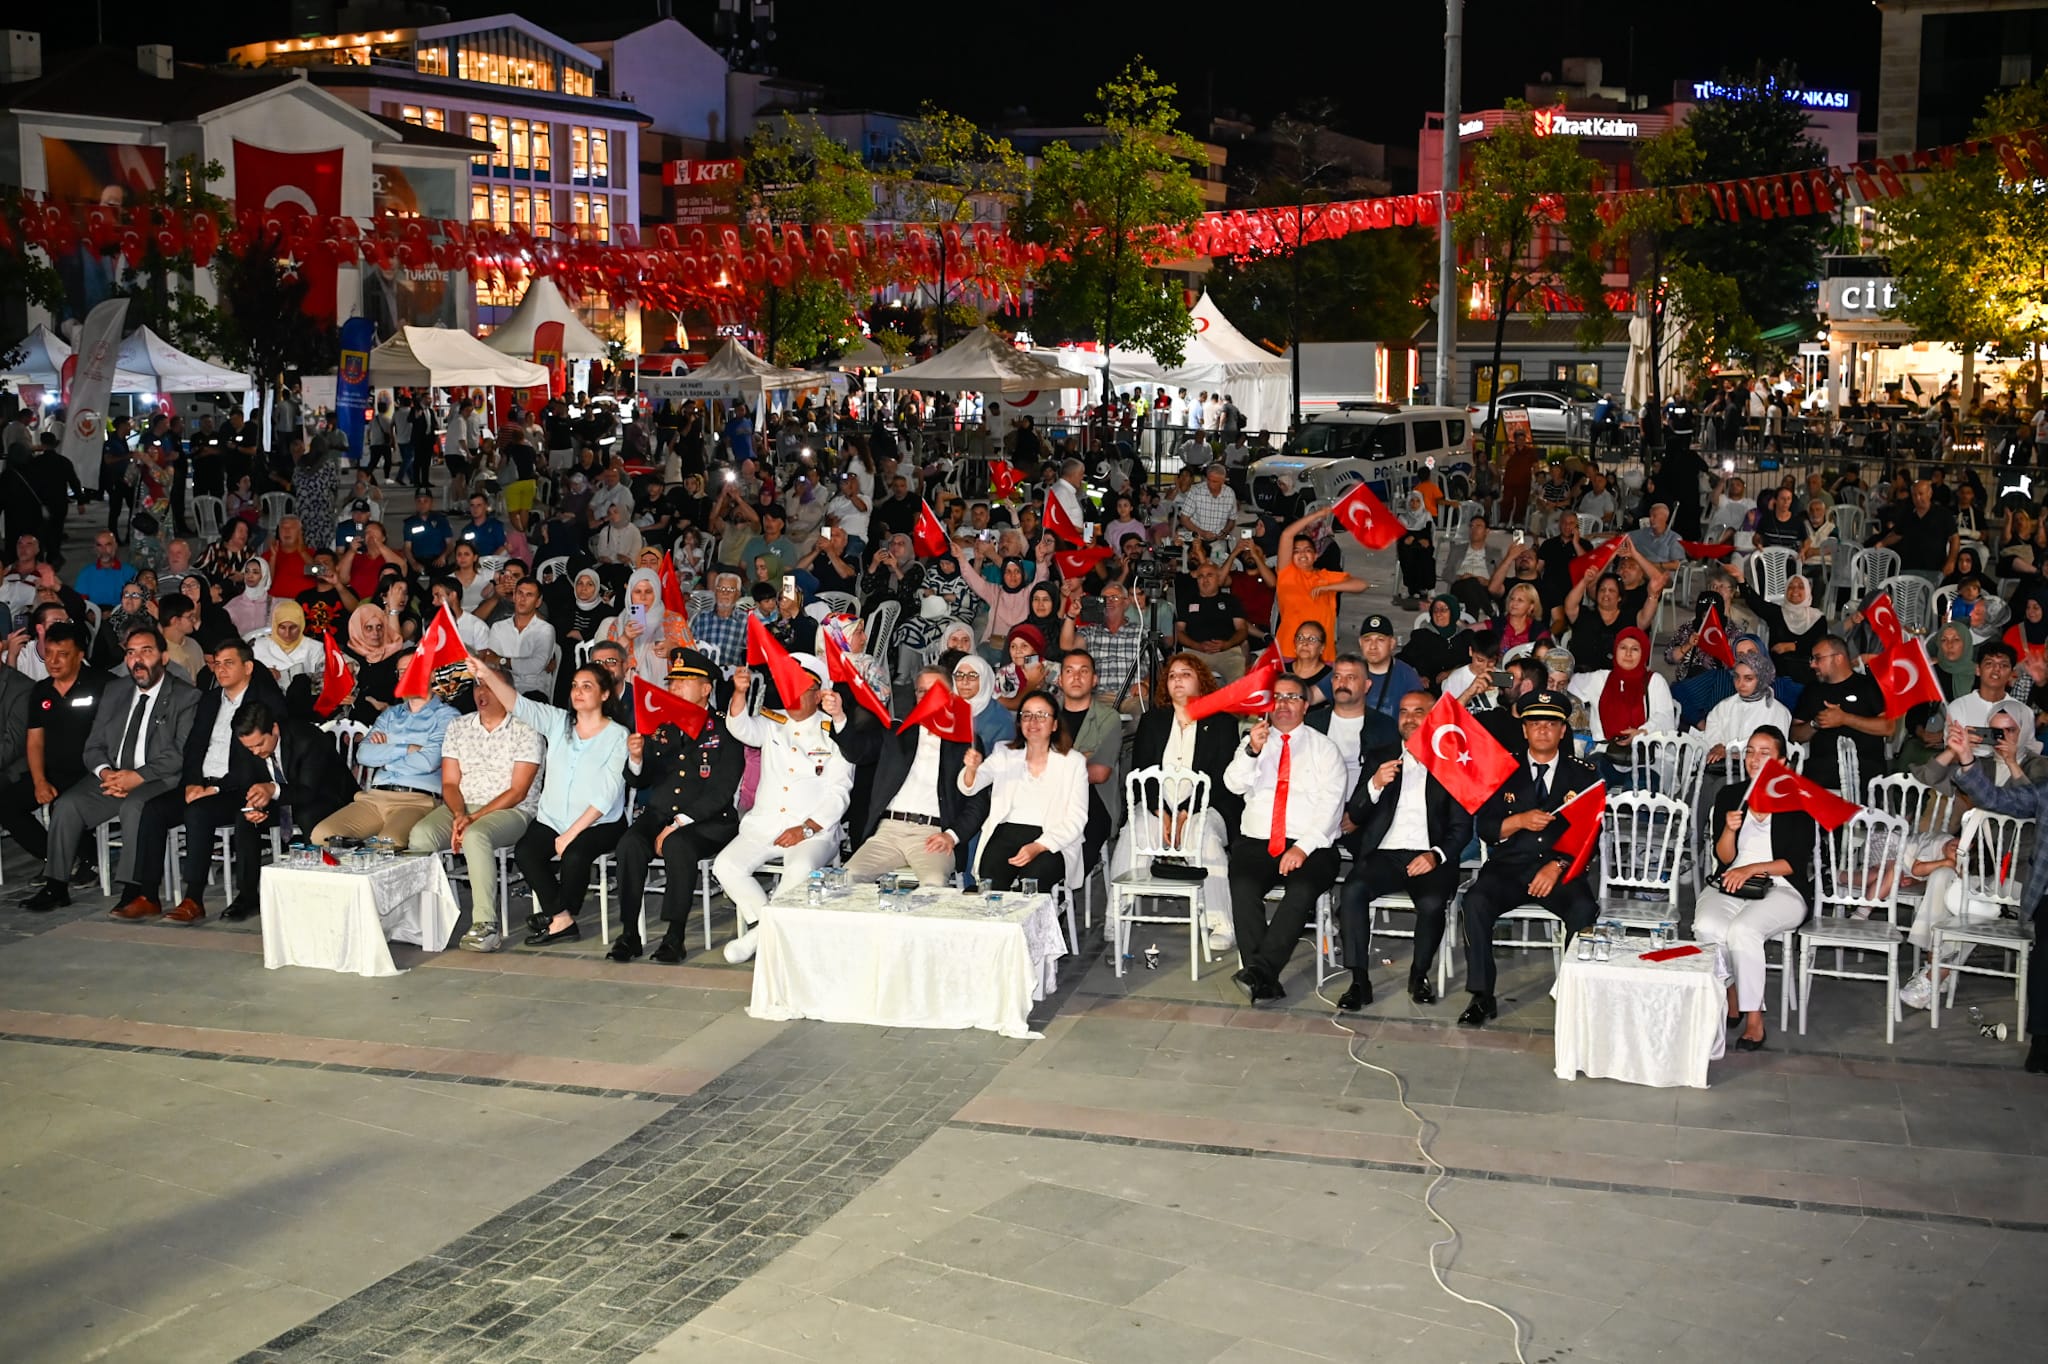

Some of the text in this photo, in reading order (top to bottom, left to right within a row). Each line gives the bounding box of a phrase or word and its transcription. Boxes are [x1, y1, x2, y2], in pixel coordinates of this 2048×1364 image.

[1552, 116, 1638, 137] Ziraat Katılım
[696, 164, 734, 181] KFC
[717, 324, 742, 336] KFC
